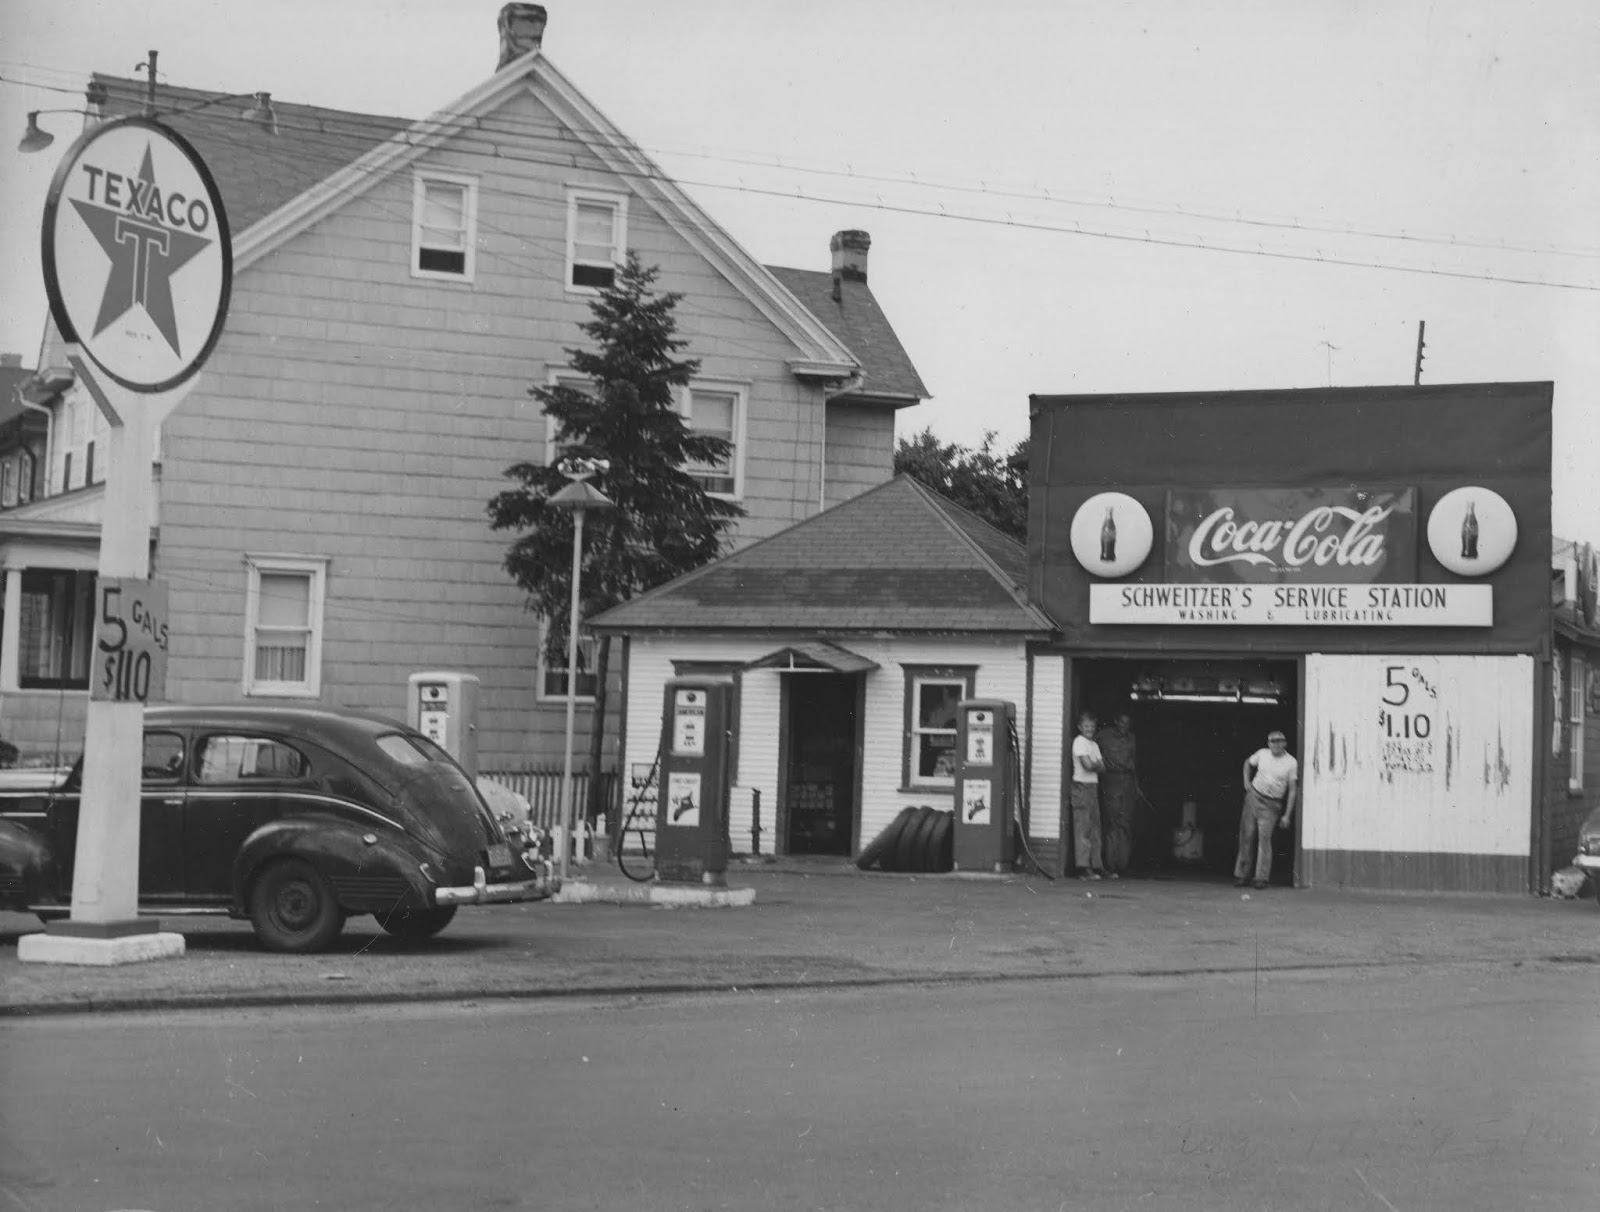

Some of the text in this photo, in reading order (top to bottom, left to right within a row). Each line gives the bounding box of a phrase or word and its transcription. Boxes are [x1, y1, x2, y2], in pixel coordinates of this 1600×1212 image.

[83, 163, 209, 233] TEXACO
[1189, 505, 1395, 567] Coca-Cola
[1121, 587, 1447, 608] SCHWEITZER'S SERVICE STATION
[1178, 609, 1394, 621] WASHING & LUBRICATING
[98, 587, 169, 653] 5 GALS
[1382, 666, 1438, 706] 5 GALS
[1379, 707, 1431, 739] $1.10
